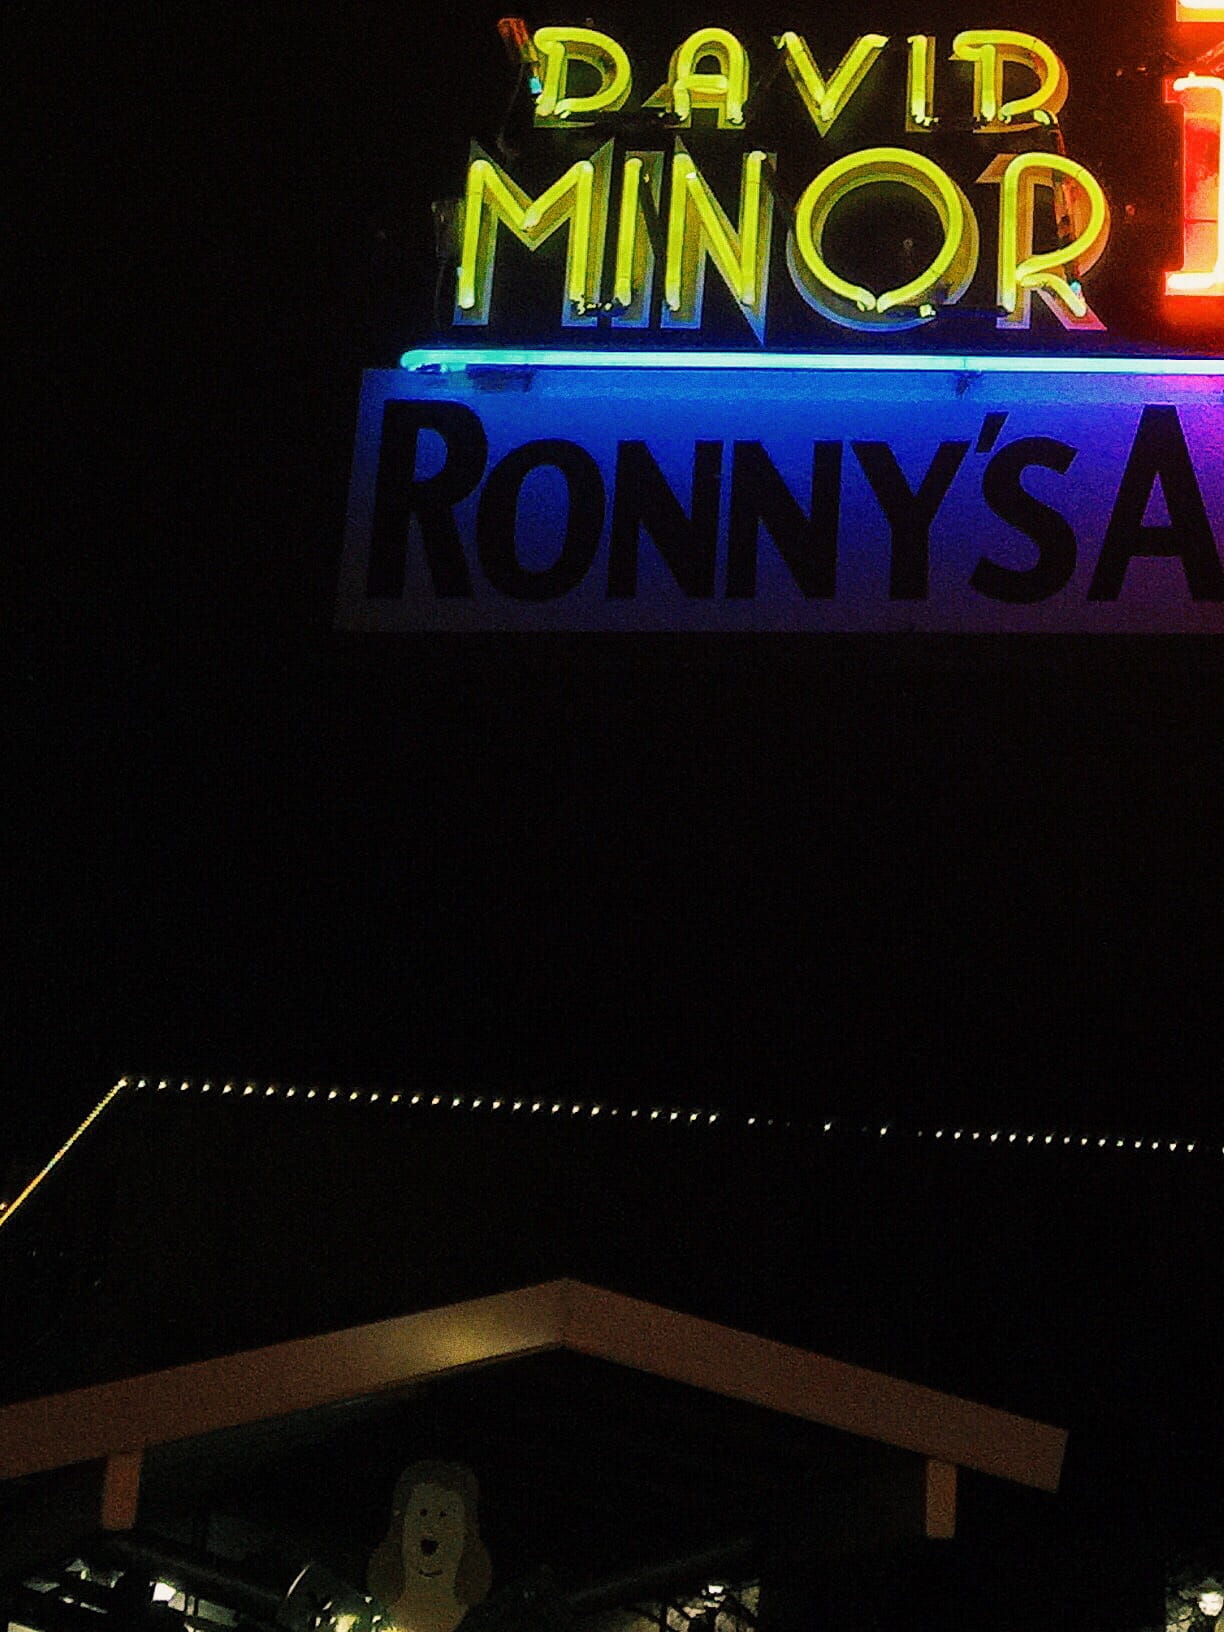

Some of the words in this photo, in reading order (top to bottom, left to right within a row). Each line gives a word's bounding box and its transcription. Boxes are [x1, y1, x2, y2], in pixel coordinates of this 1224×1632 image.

[530, 26, 1070, 136] DAVID
[453, 139, 1111, 341] MINOR
[366, 398, 1076, 604] RONNY'S
